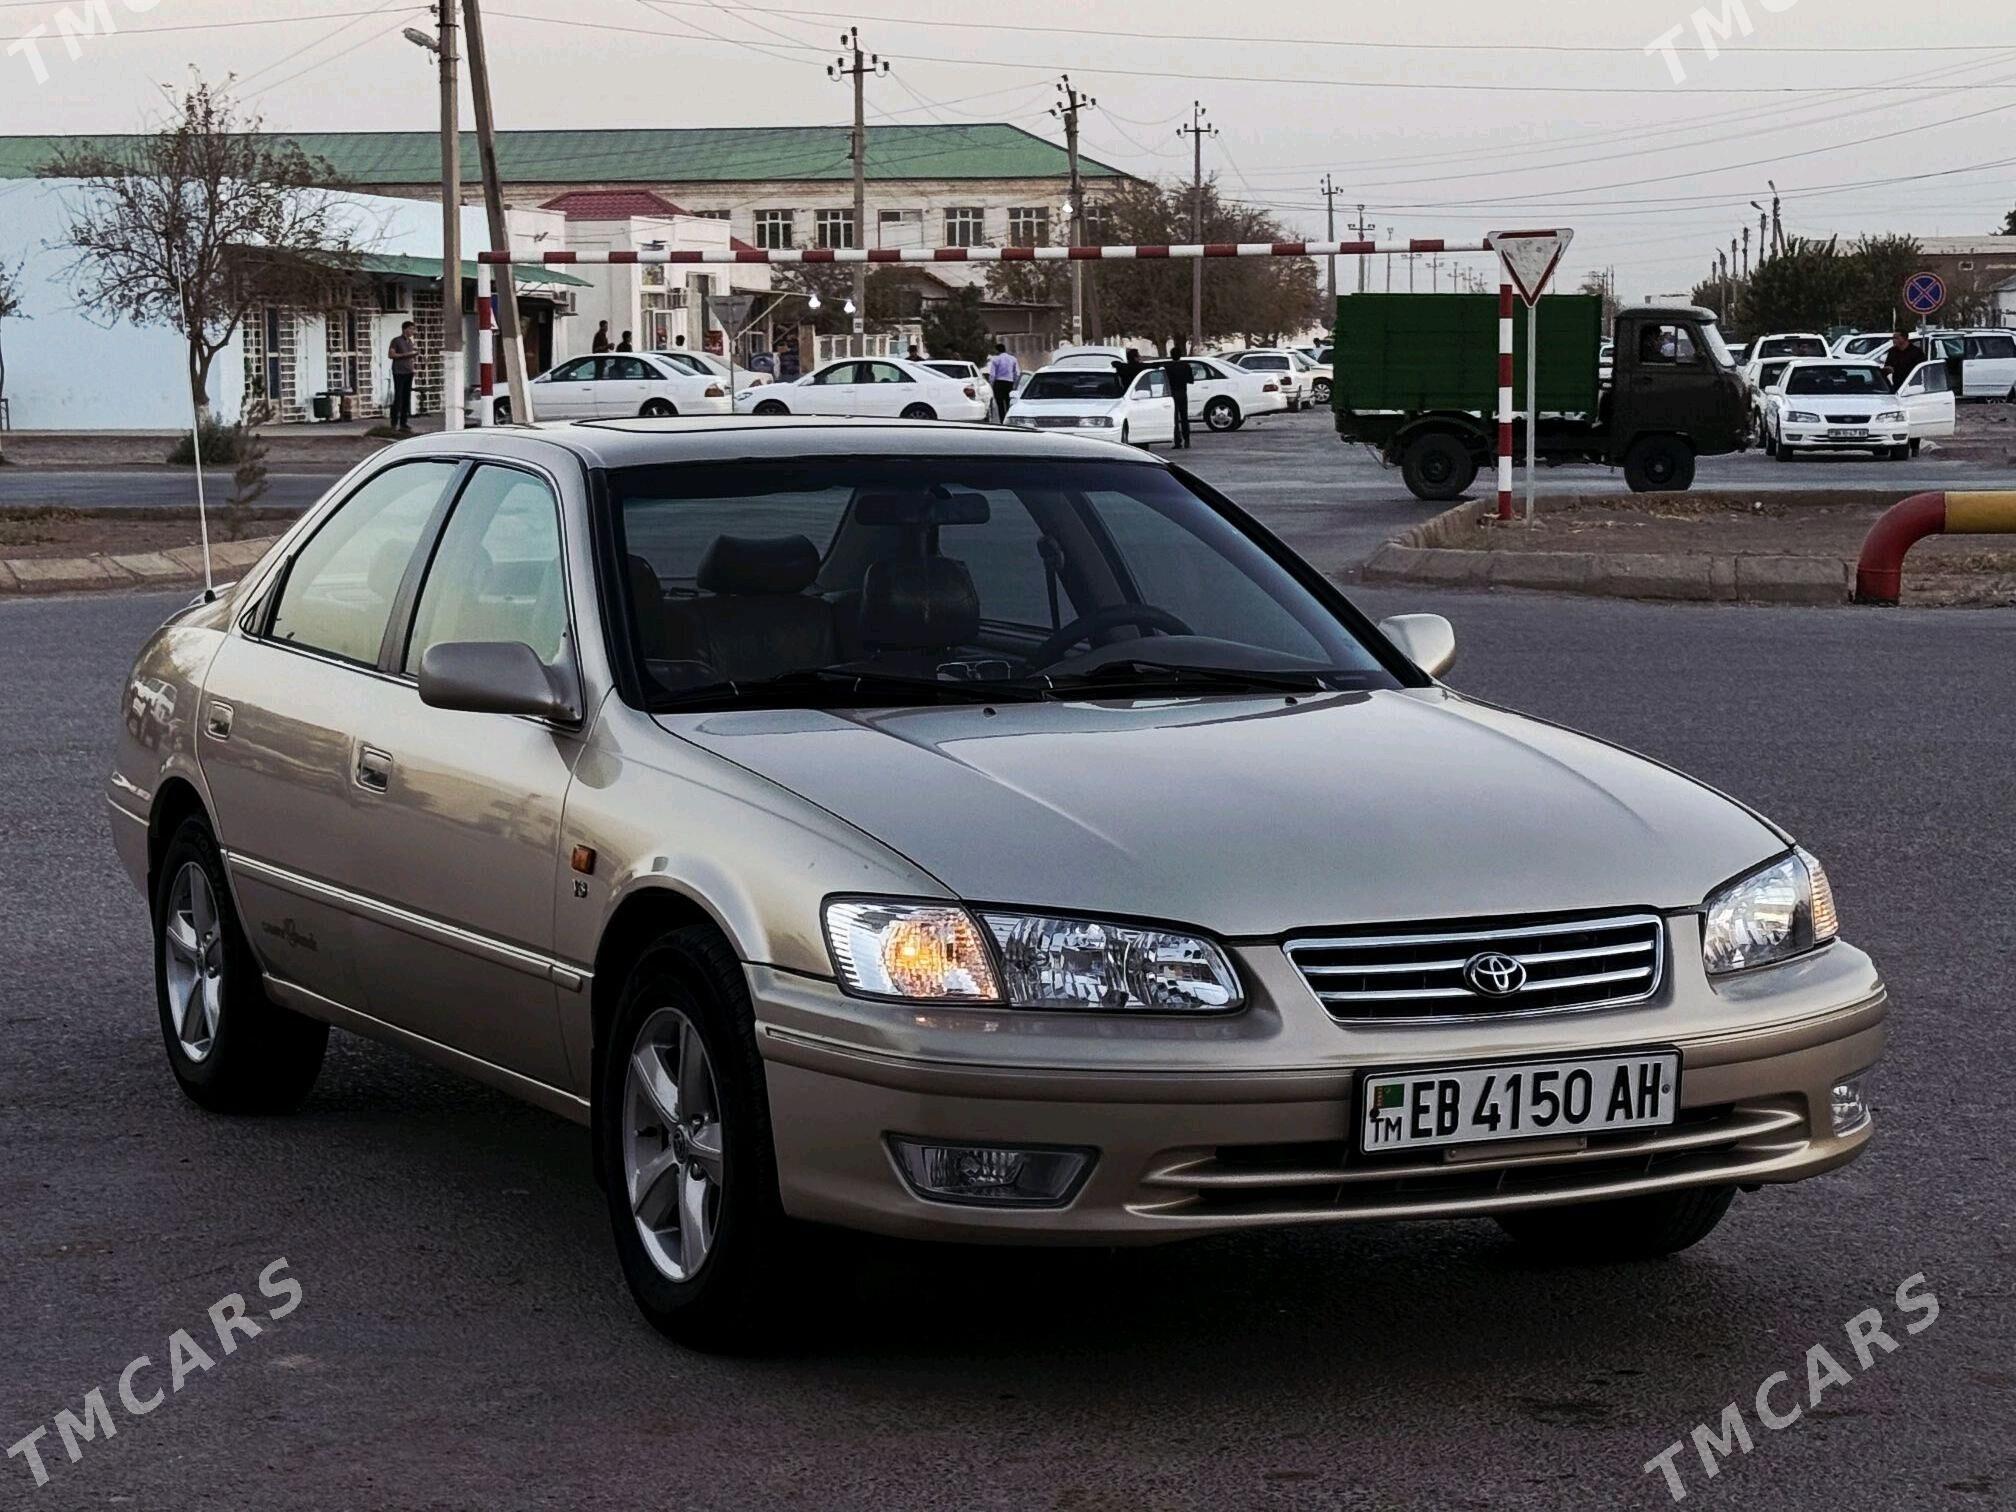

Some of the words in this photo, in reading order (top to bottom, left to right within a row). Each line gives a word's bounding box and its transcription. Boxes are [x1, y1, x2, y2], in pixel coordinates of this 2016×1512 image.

[1410, 1079, 1460, 1139] EB
[1472, 1068, 1593, 1132] 4150
[1605, 1062, 1662, 1122] AH
[1371, 1115, 1402, 1143] TM
